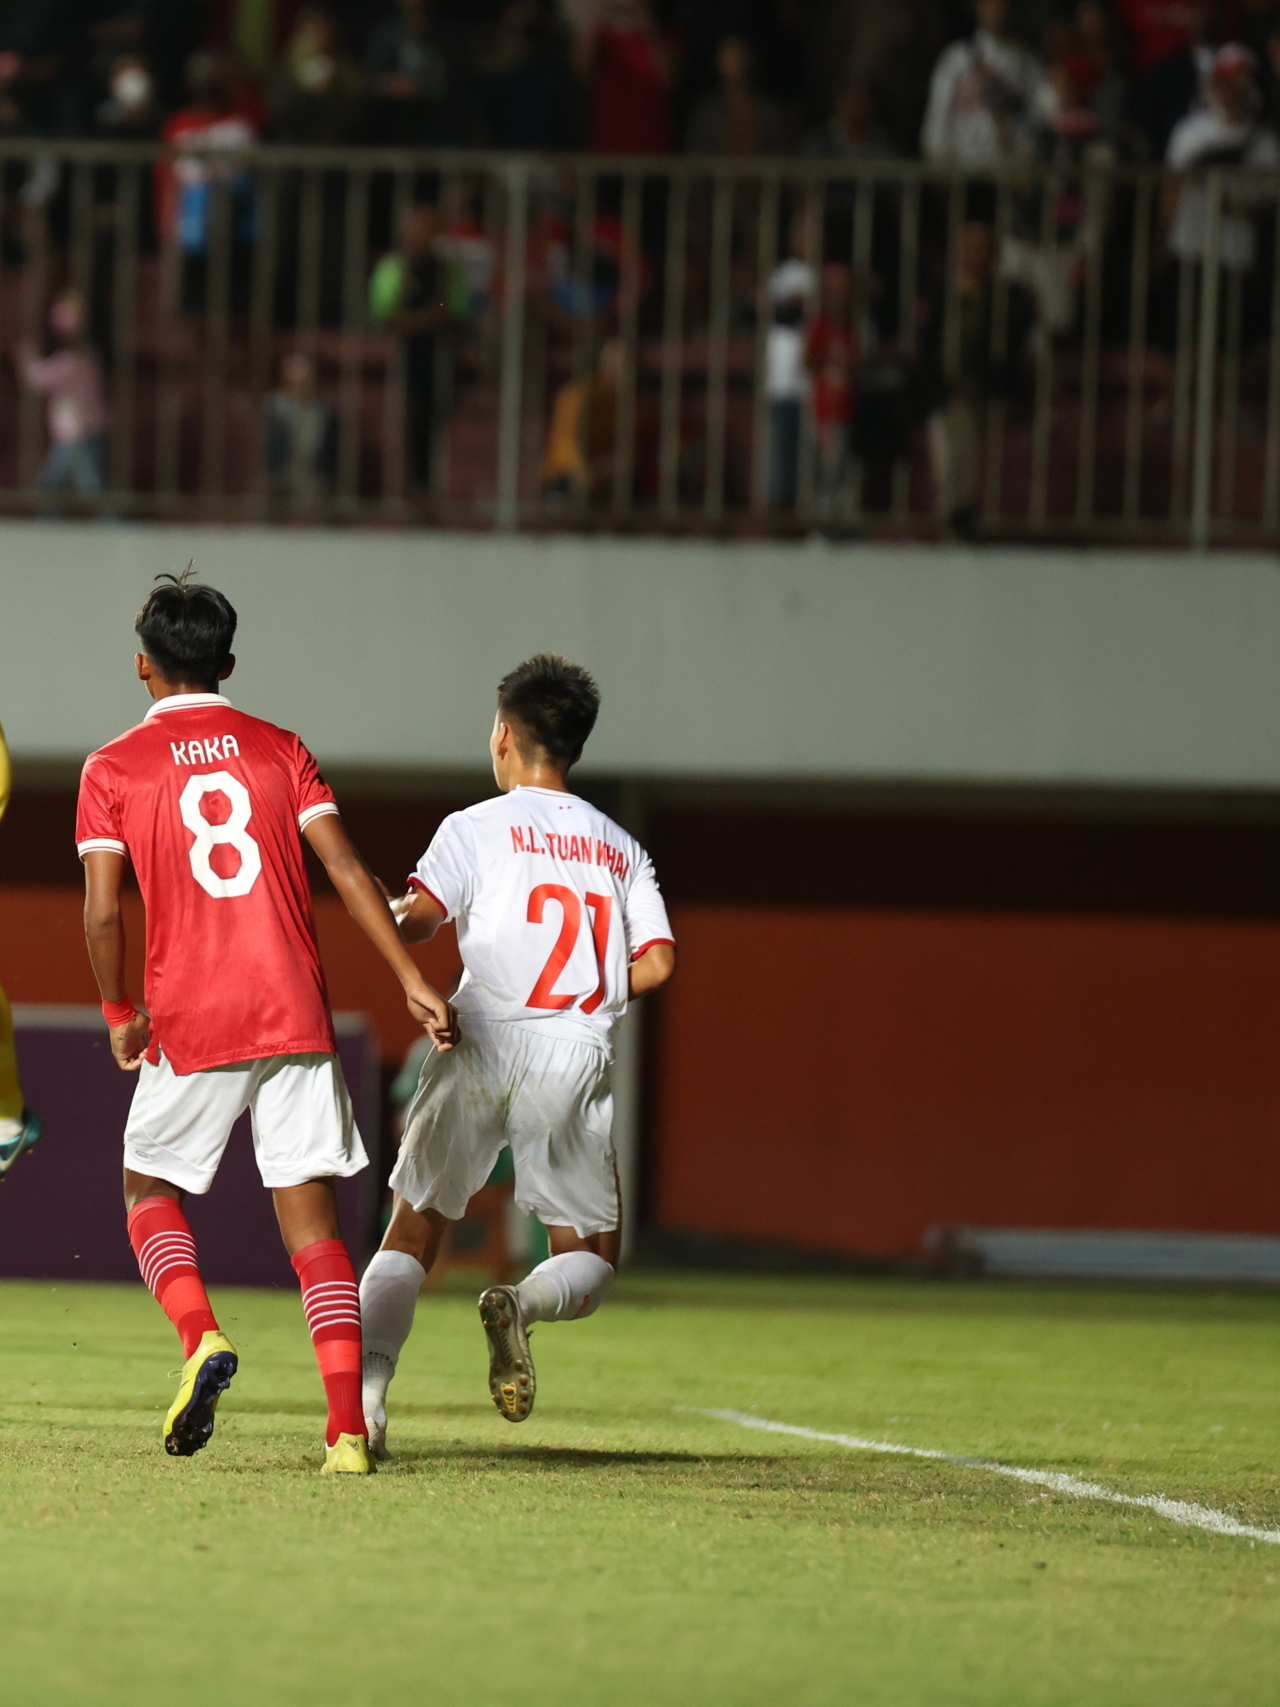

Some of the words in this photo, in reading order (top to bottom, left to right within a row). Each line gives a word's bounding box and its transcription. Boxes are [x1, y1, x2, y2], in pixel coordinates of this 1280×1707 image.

[169, 734, 241, 766] KAKA
[178, 770, 263, 899] 8
[545, 832, 593, 865] TUAN
[525, 883, 614, 1015] 21
